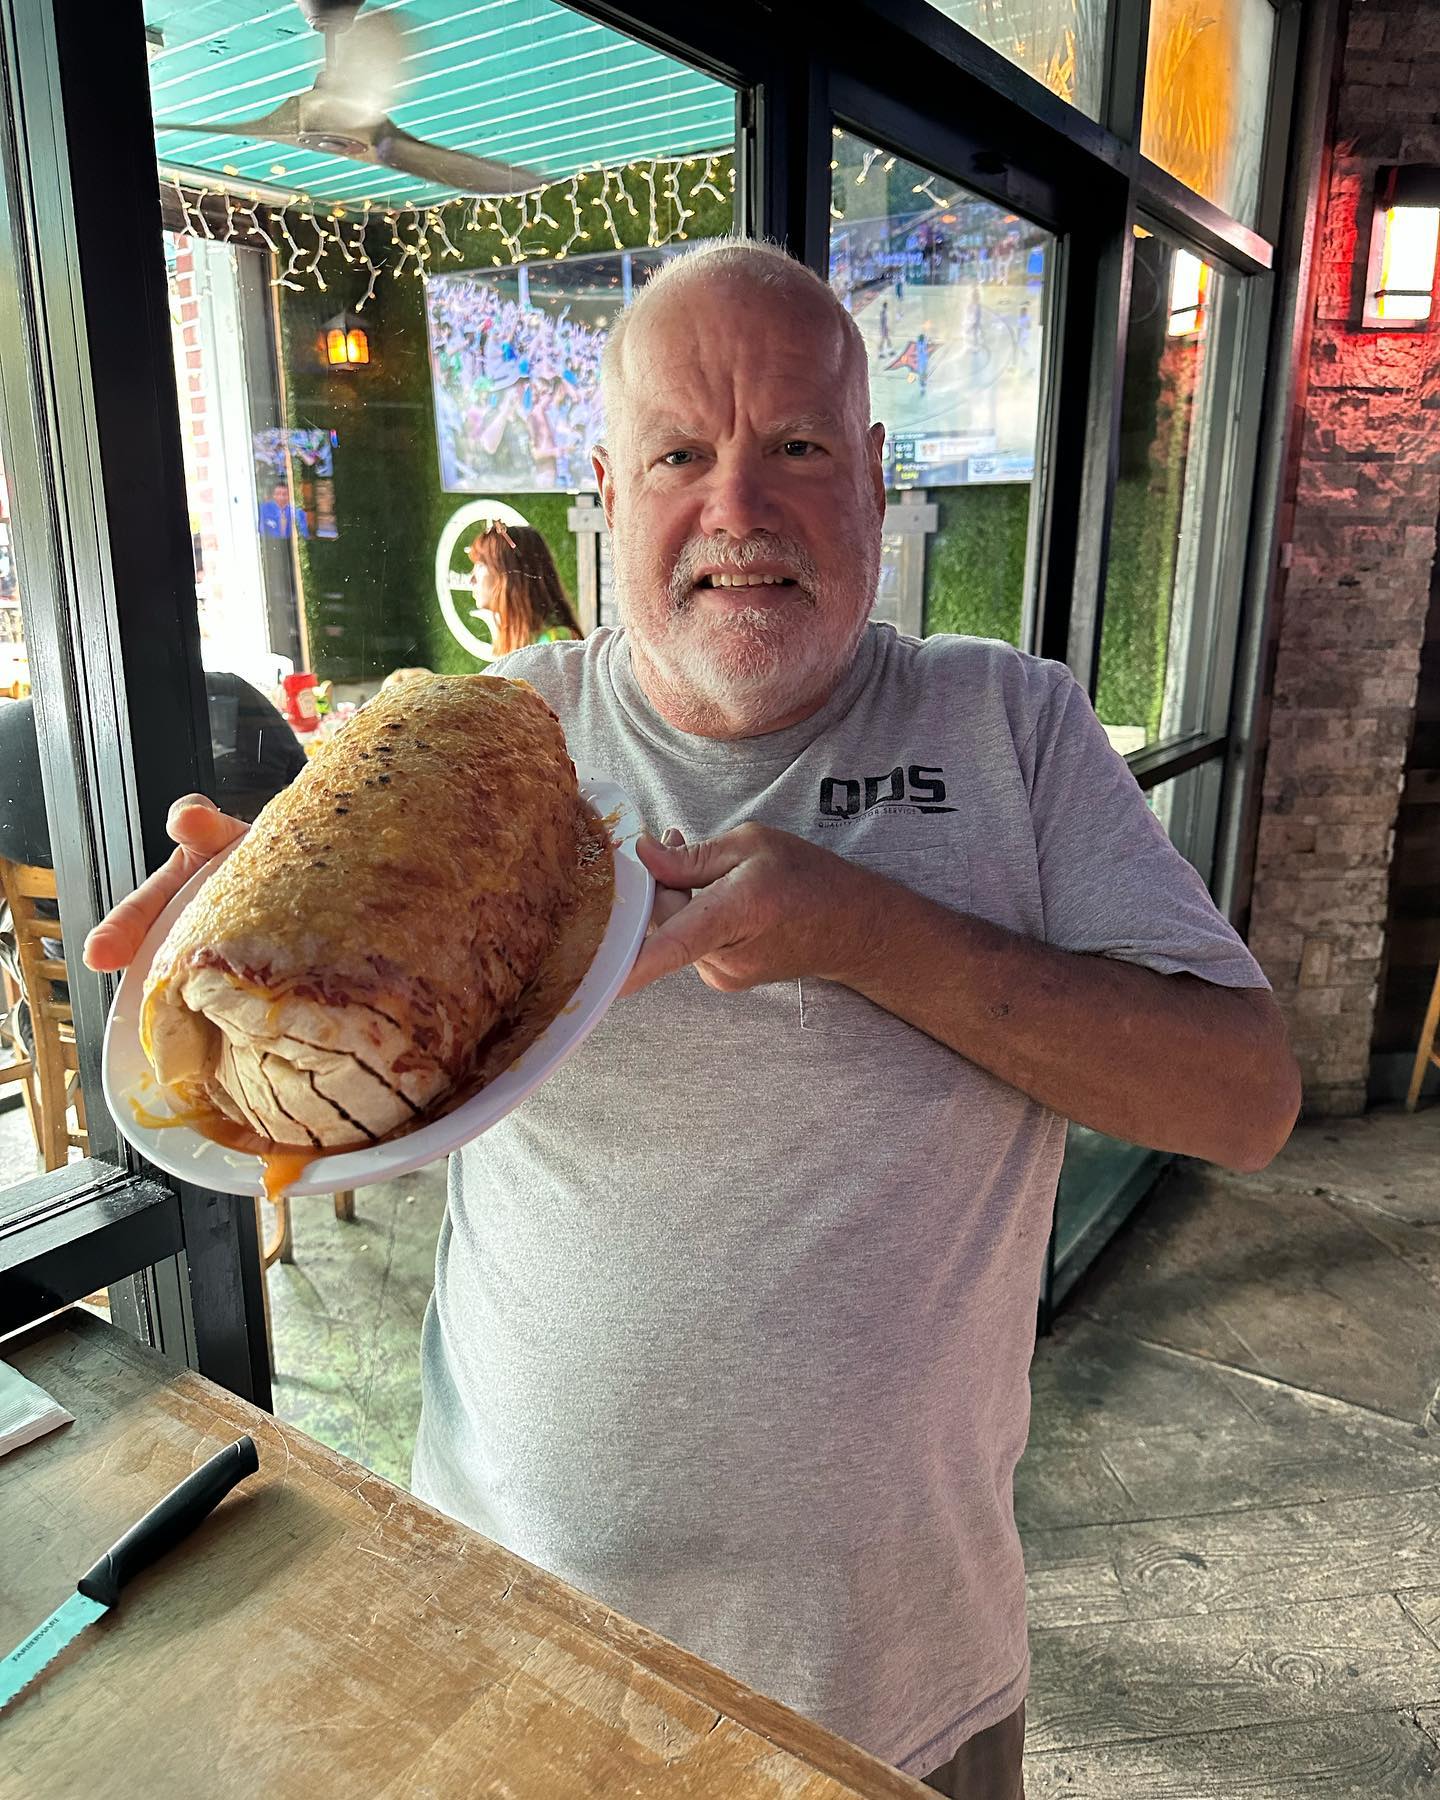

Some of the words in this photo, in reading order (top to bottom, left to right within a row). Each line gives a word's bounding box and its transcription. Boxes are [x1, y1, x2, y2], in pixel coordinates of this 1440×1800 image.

[819, 764, 947, 819] QDS
[818, 820, 853, 829] QUALITY
[883, 807, 917, 815] SERVICE
